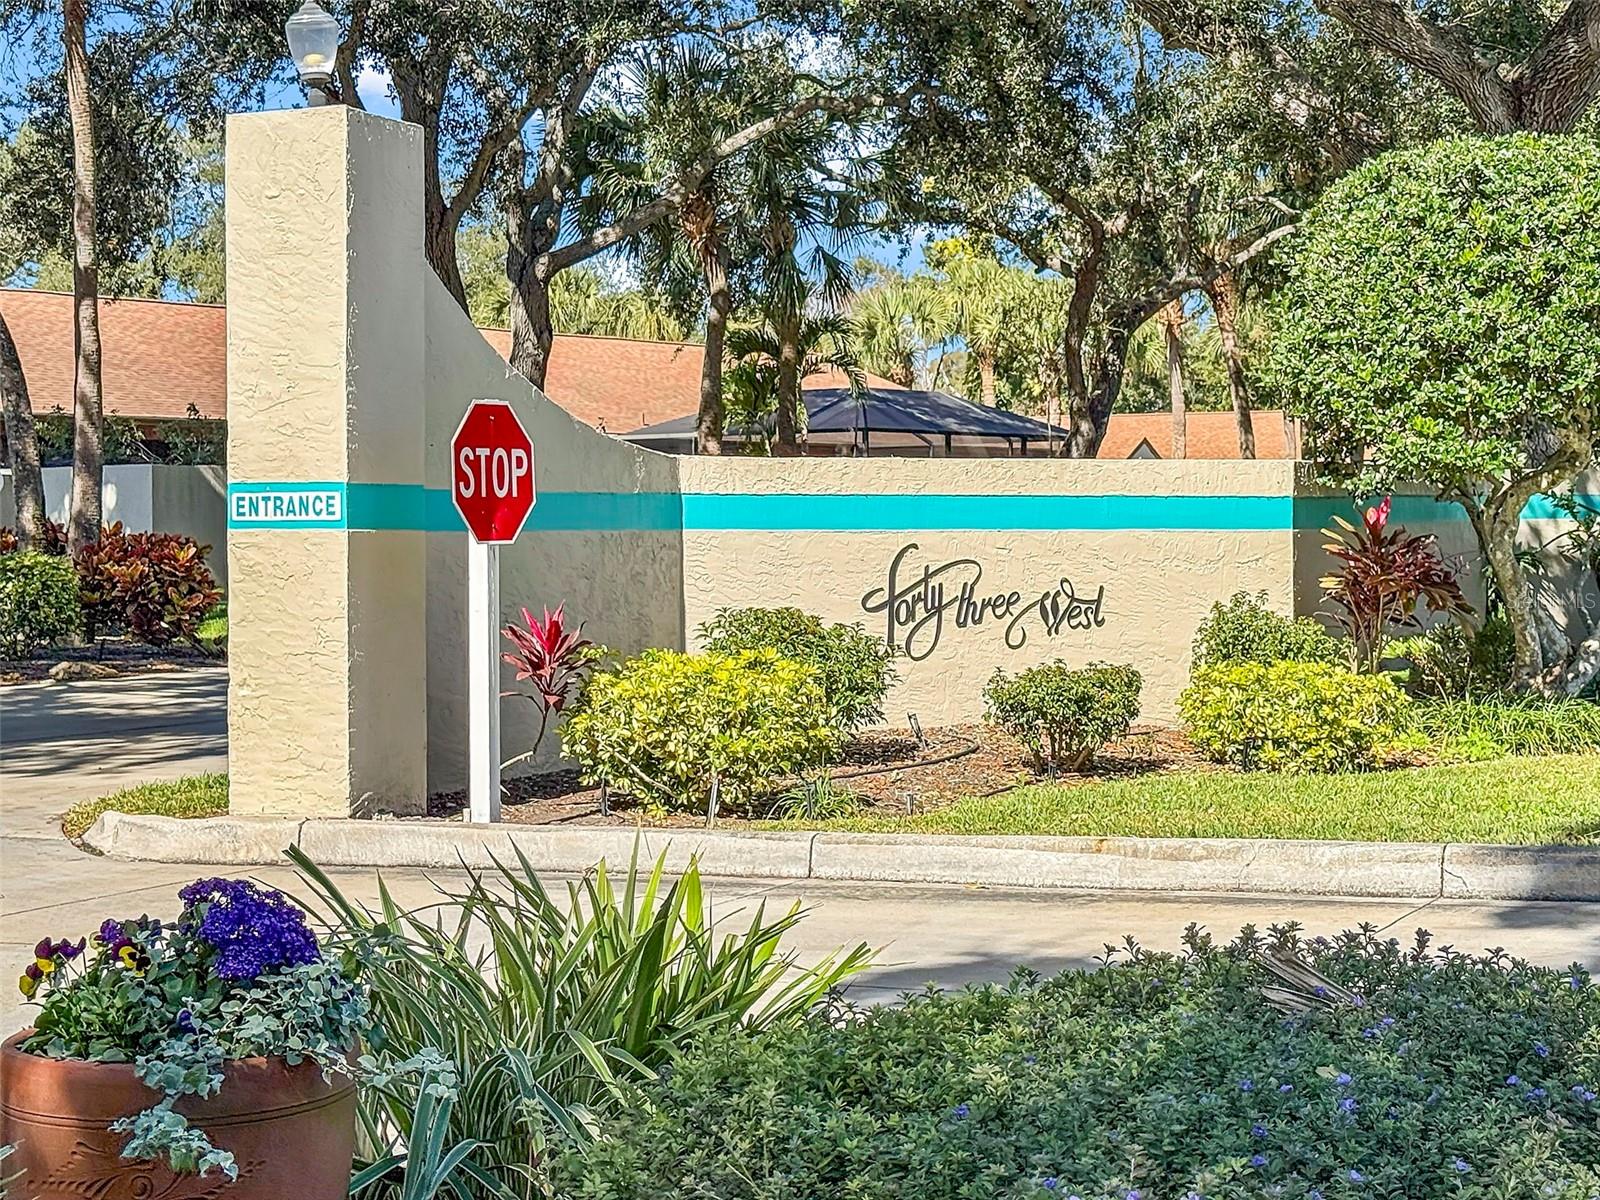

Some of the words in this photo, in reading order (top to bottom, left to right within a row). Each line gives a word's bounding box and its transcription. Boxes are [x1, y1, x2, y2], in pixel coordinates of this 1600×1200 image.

[459, 446, 528, 498] STOP
[236, 495, 336, 516] ENTRANCE
[955, 582, 1021, 628] three
[1005, 577, 1105, 650] West
